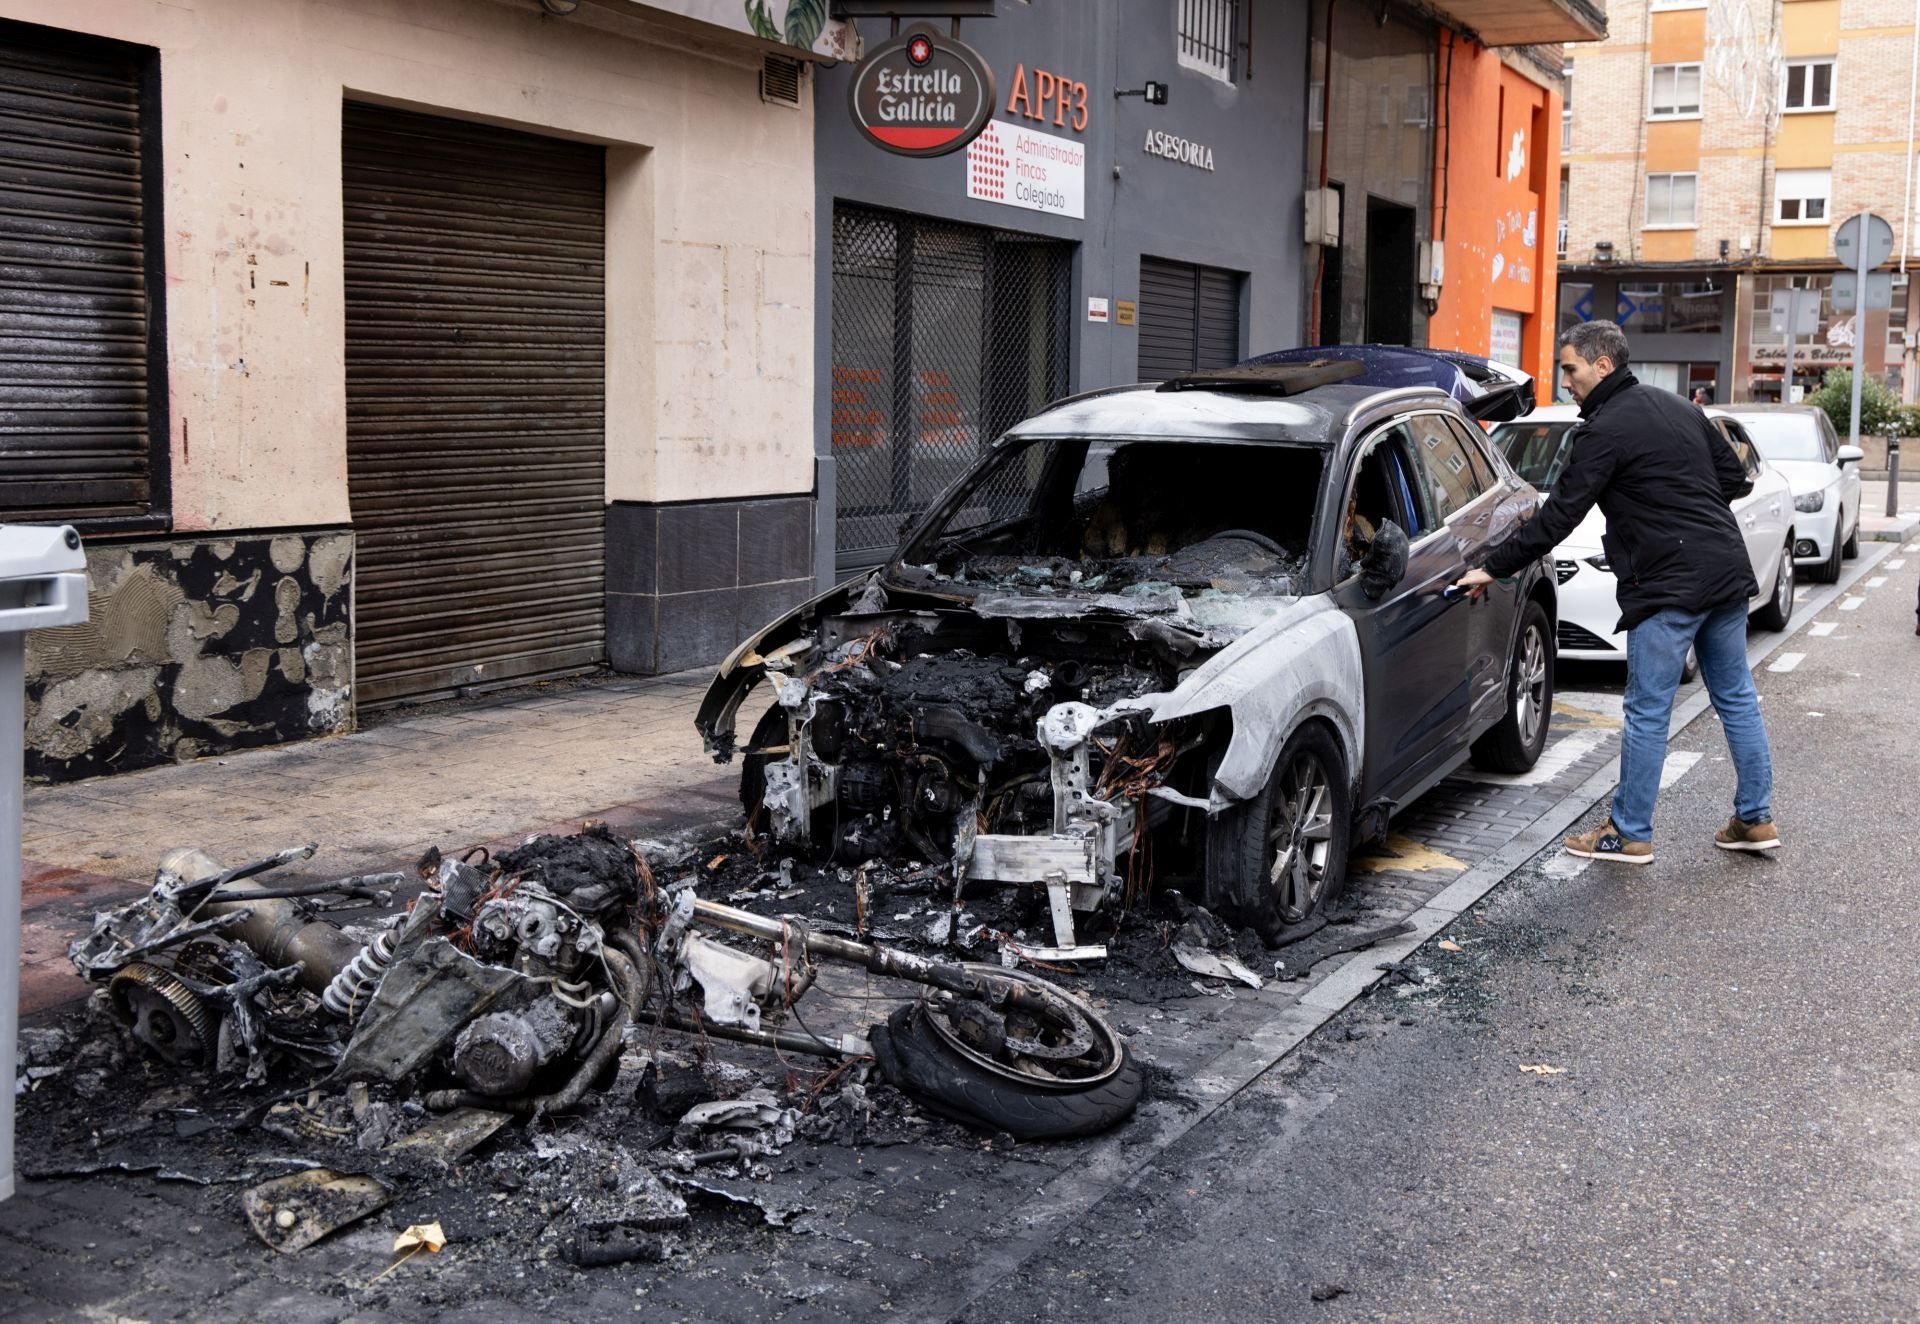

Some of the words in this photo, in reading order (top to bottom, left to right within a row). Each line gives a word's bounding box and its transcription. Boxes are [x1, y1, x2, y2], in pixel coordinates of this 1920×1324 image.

[876, 67, 962, 94] Estrella
[878, 94, 956, 122] Galicia
[1005, 64, 1088, 131] APF3
[1015, 133, 1083, 166] Administrador
[1144, 128, 1214, 171] ASESORIA
[1015, 158, 1047, 181] Fincas
[1015, 182, 1065, 208] Colegiado
